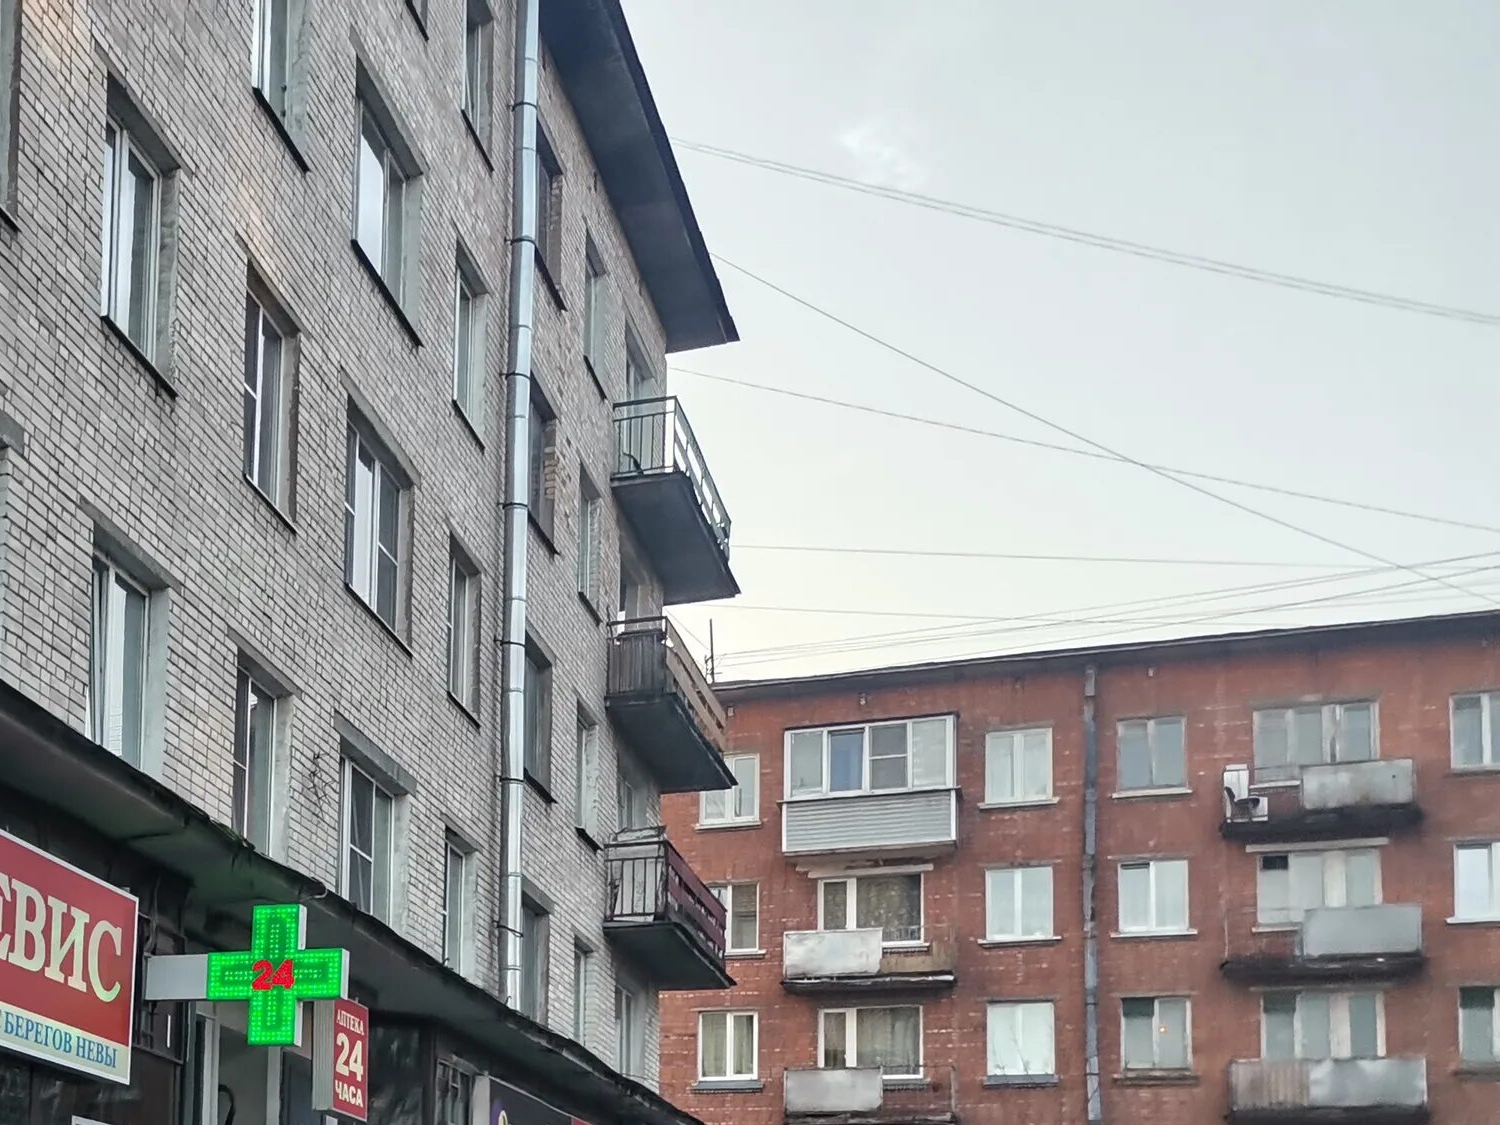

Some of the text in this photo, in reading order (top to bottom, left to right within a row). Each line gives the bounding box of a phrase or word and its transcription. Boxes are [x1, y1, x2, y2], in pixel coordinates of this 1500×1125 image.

[252, 959, 296, 991] 24
[336, 1009, 365, 1036] АПТЕКА
[3, 1010, 73, 1054] БЕРЕГОВ
[75, 1035, 118, 1069] НЕВЫ
[335, 1032, 364, 1082] 24
[334, 1079, 364, 1108] ЧАСА
